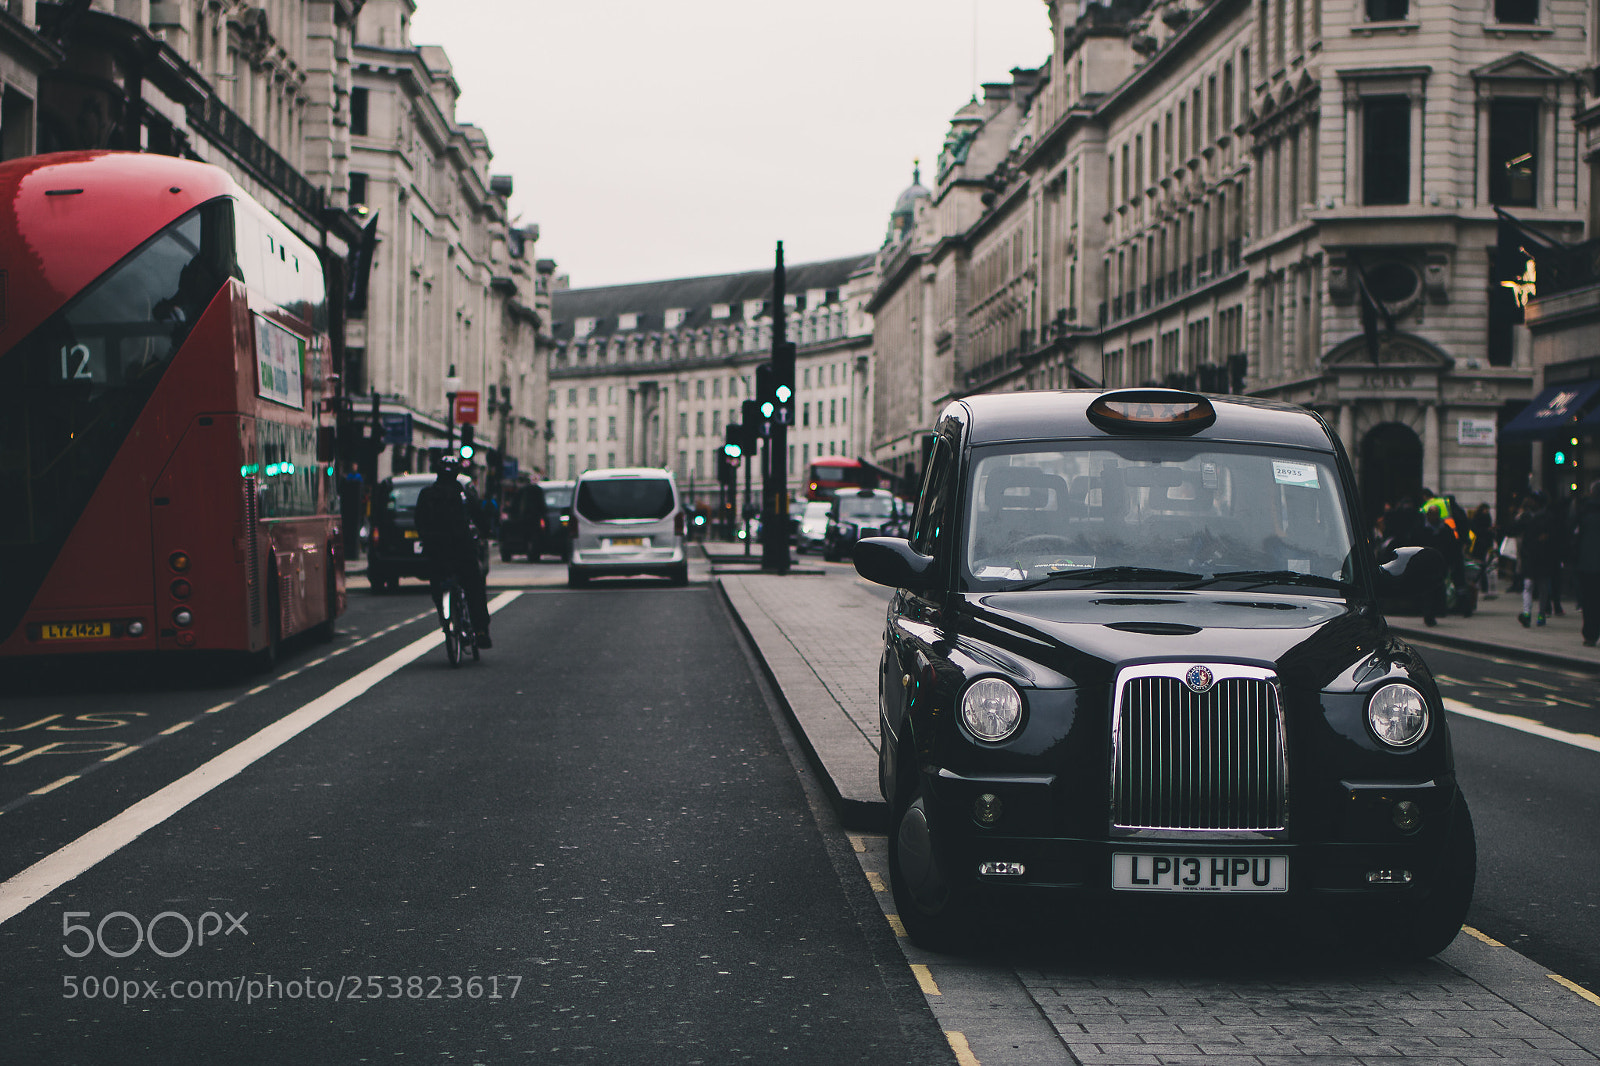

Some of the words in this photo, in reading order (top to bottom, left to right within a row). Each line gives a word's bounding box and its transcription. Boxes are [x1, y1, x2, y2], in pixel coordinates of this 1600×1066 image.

[61, 344, 92, 379] 12
[1121, 402, 1190, 419] TAXI
[1131, 856, 1201, 886] LP13
[1210, 858, 1271, 887] HPU
